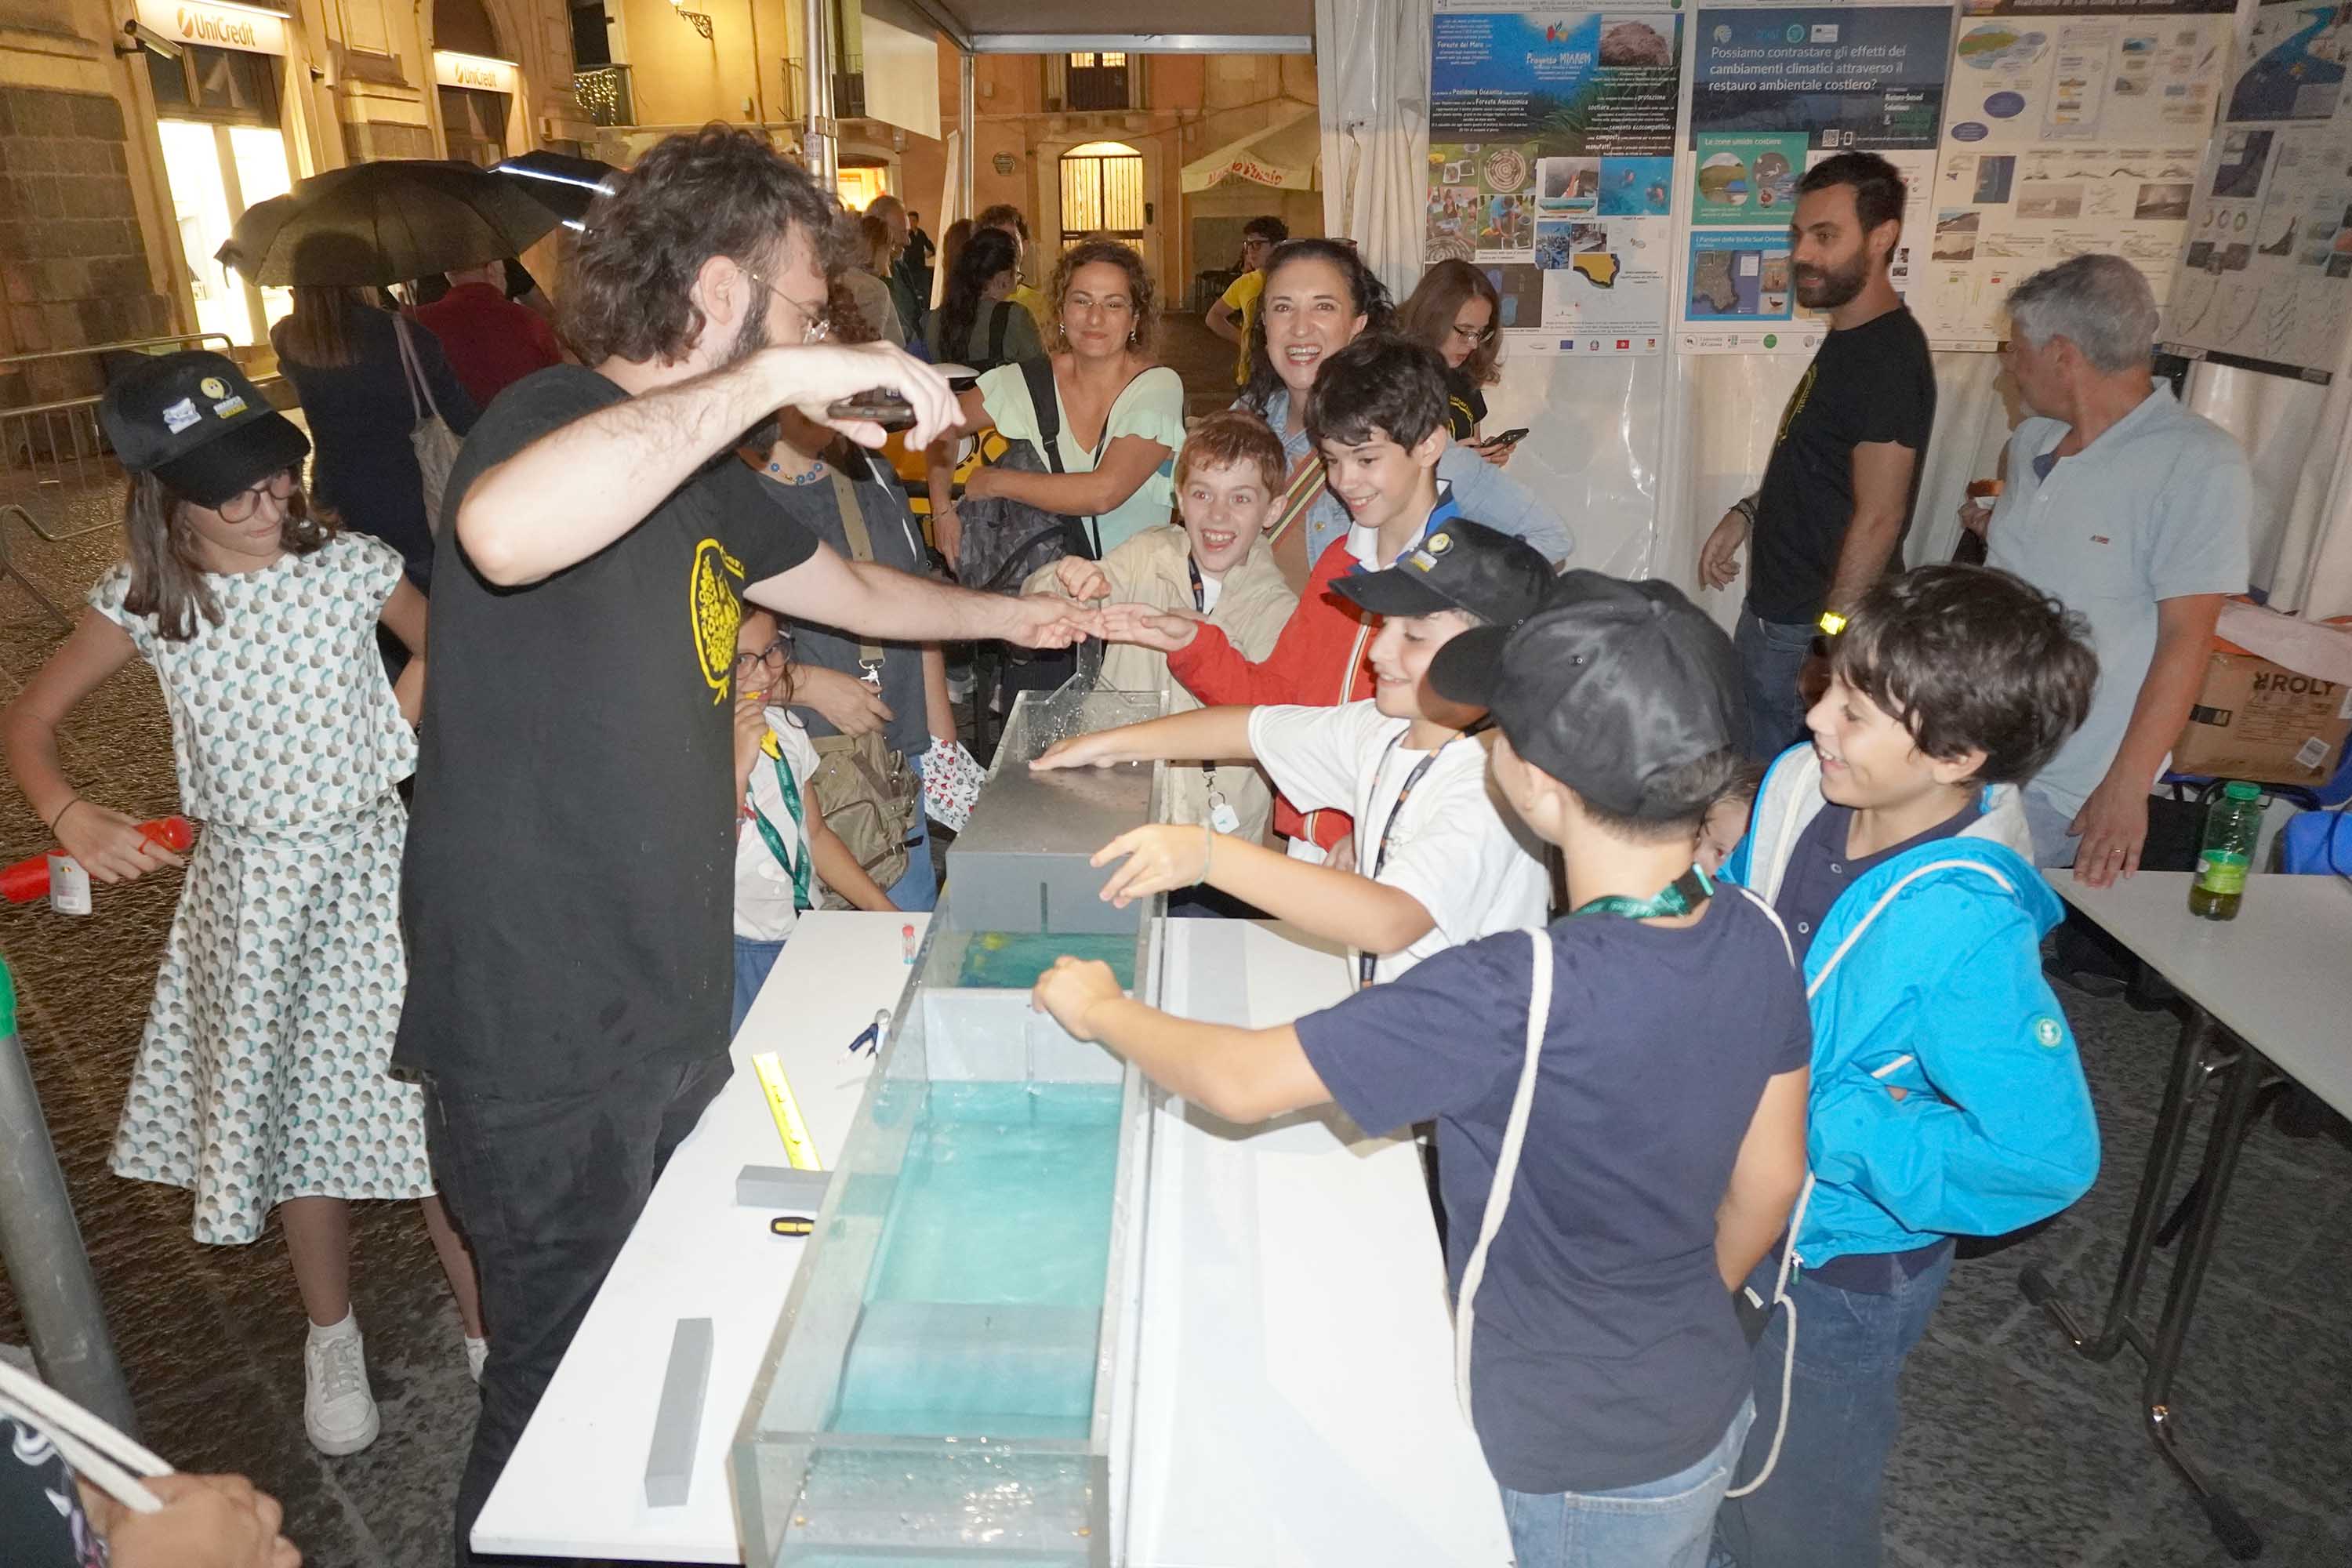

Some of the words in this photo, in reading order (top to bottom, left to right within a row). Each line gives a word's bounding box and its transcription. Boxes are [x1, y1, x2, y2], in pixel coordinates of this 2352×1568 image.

[194, 13, 256, 47] UniCredit
[1711, 46, 1765, 59] Possiamo
[1767, 47, 1832, 58] contrastare
[1835, 45, 1849, 60] gli
[1850, 45, 1886, 57] effetti
[464, 67, 497, 88] UniCredit
[1710, 63, 1783, 75] cambiamenti
[1786, 62, 1833, 74] climatici
[1836, 63, 1893, 74] attraverso
[1896, 62, 1904, 74] il
[1708, 81, 1757, 92] restauro
[1759, 79, 1821, 92] ambientale
[1824, 78, 1878, 91] costiero?
[2270, 674, 2336, 695] ROLY
